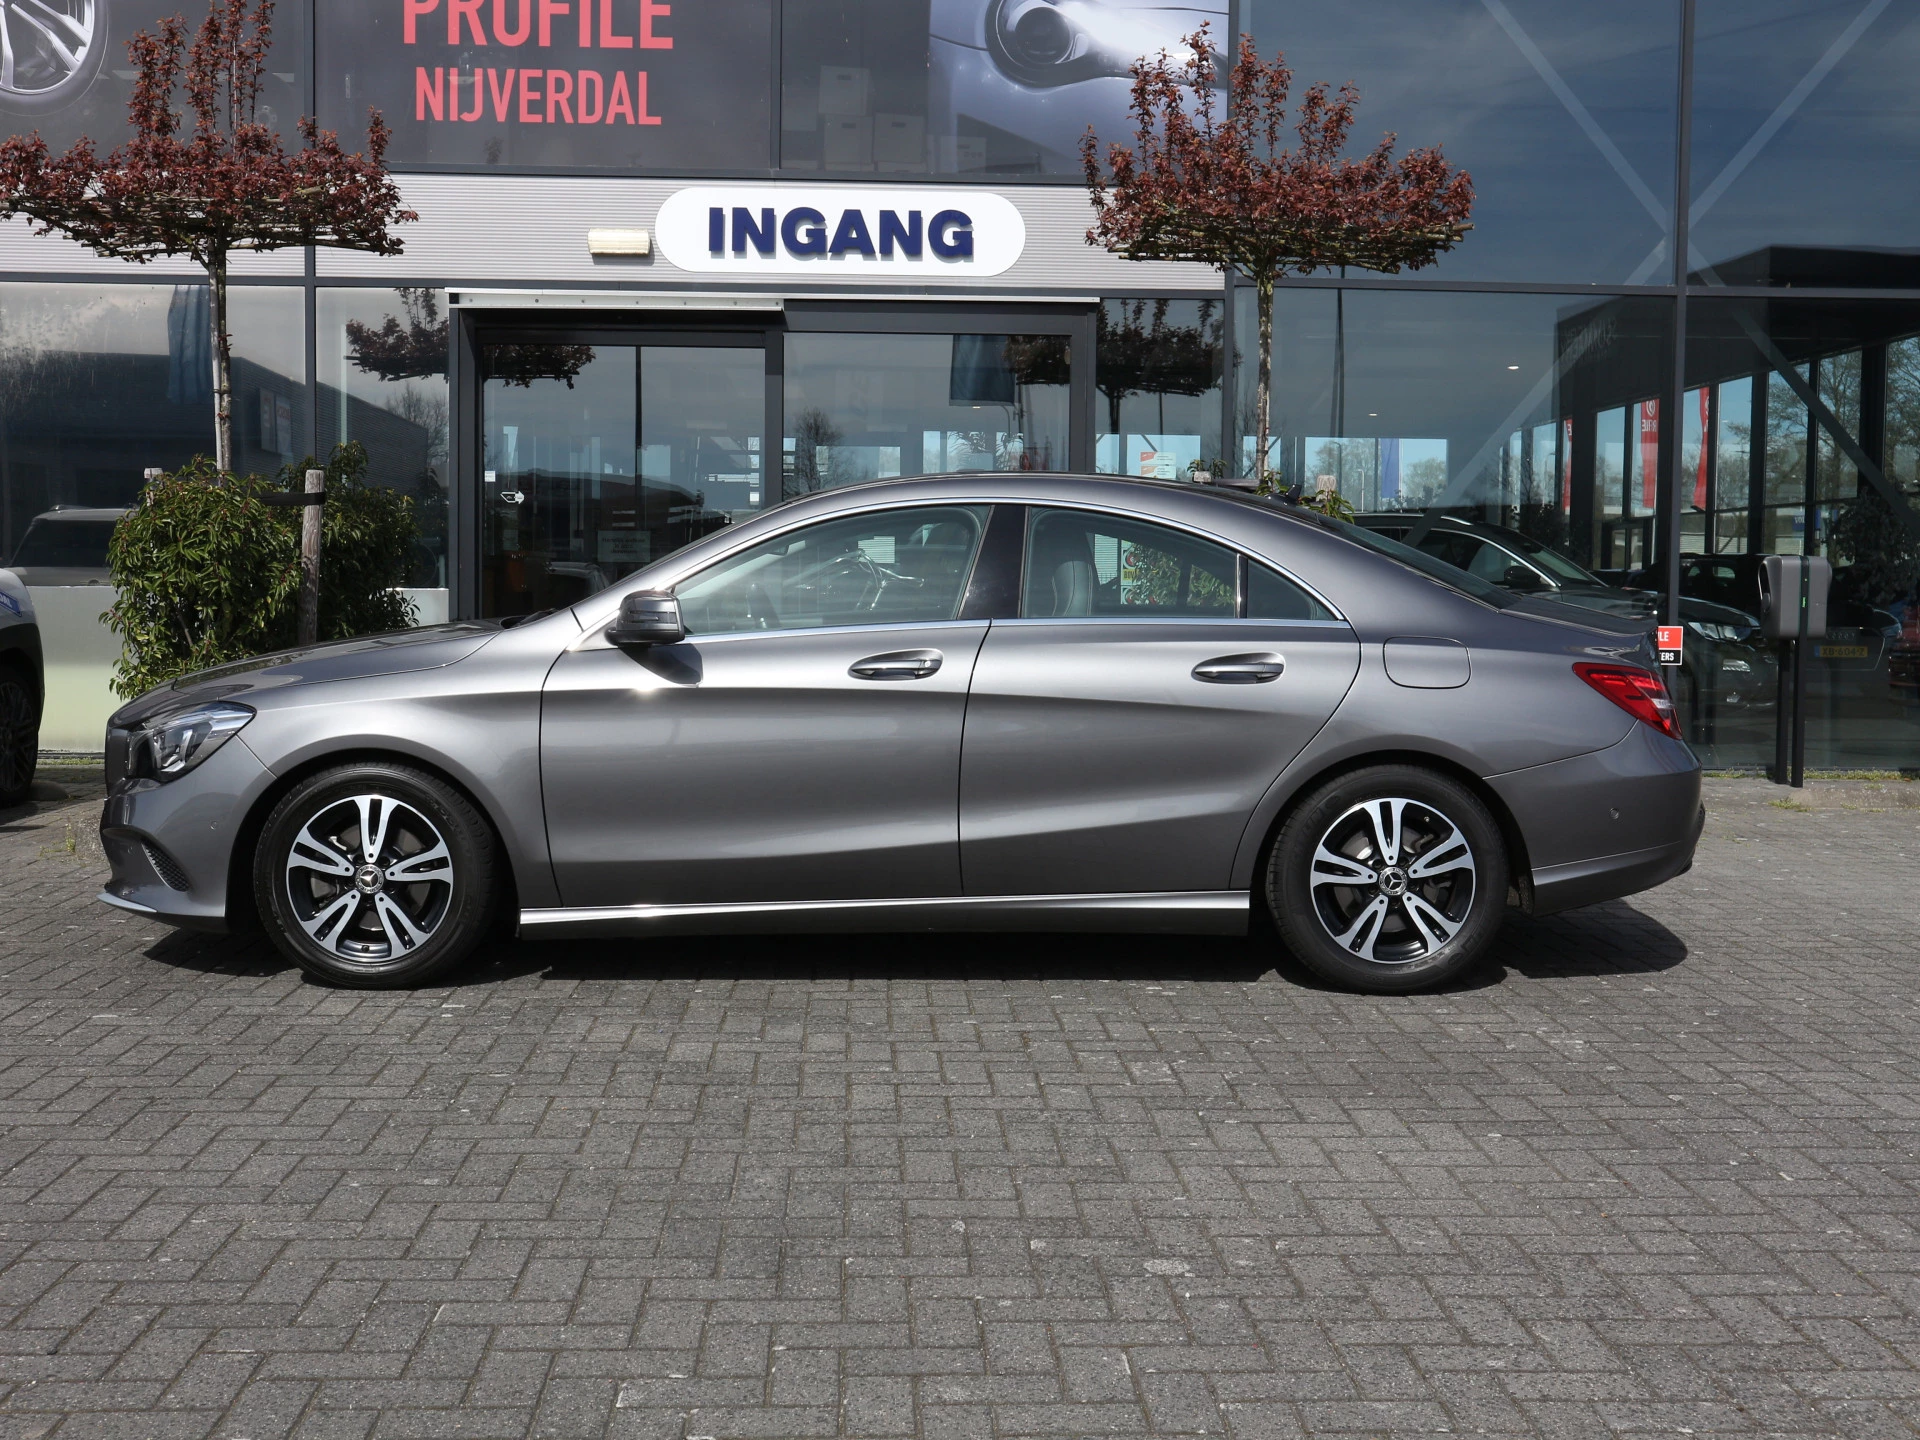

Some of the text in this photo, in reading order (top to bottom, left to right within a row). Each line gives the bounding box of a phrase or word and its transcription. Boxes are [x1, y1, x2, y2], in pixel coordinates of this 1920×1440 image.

[403, 0, 673, 49] PROFILE
[415, 66, 662, 125] NIJVERDAL
[708, 207, 974, 258] INGANG
[1660, 651, 1675, 662] ERS
